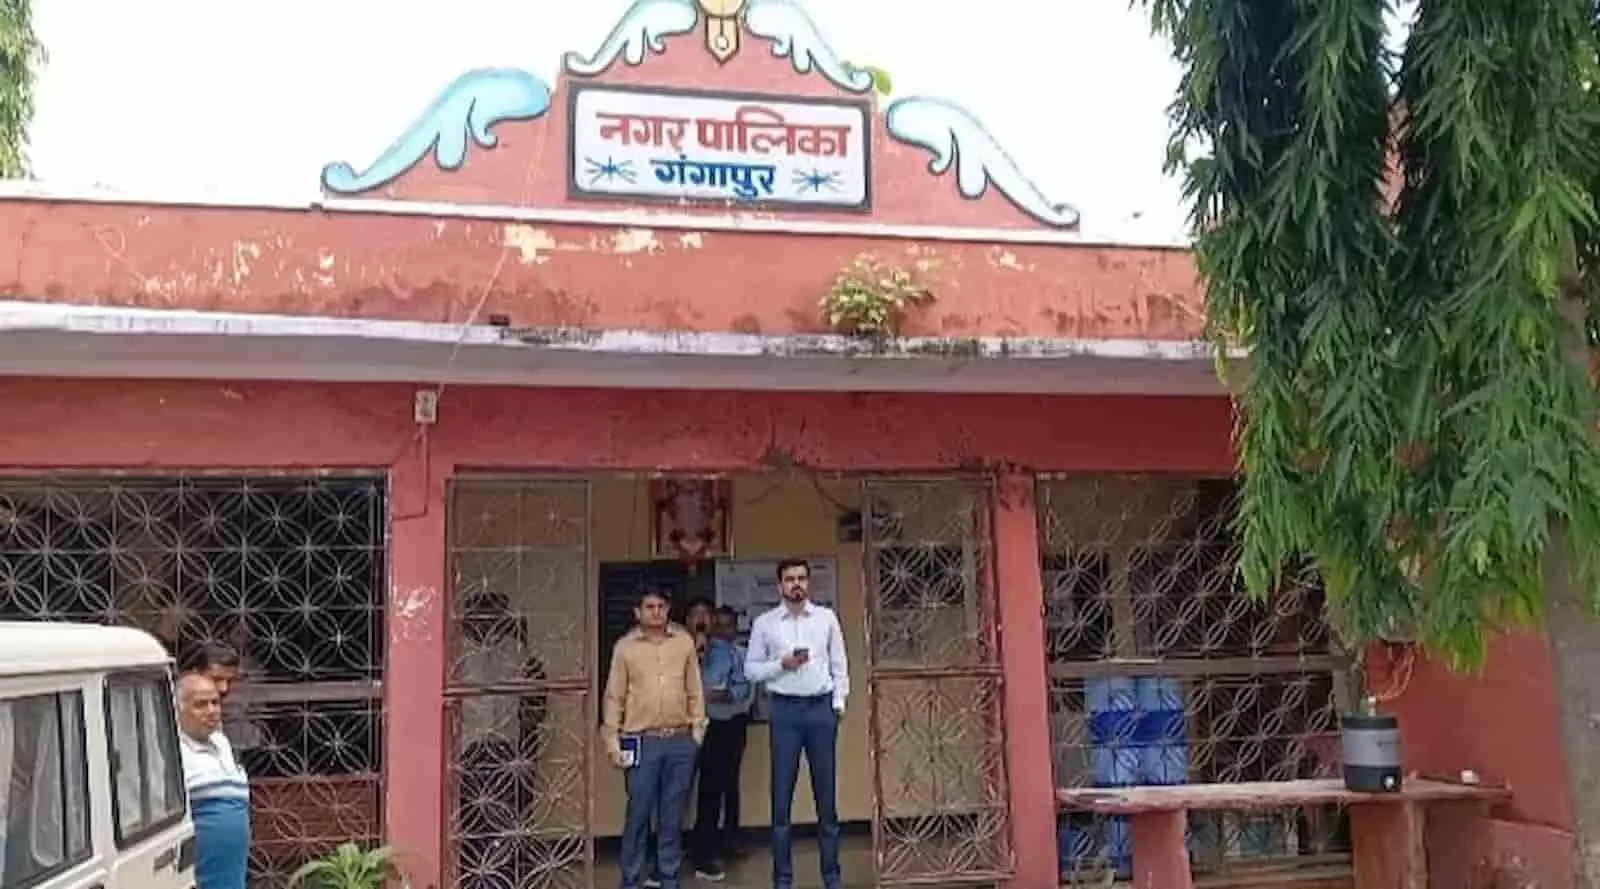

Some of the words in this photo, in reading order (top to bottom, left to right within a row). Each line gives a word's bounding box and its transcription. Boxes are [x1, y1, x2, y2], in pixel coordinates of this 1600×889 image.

[596, 112, 690, 151] नगर
[696, 105, 851, 158] पालिका
[650, 154, 776, 197] गंगापुर
